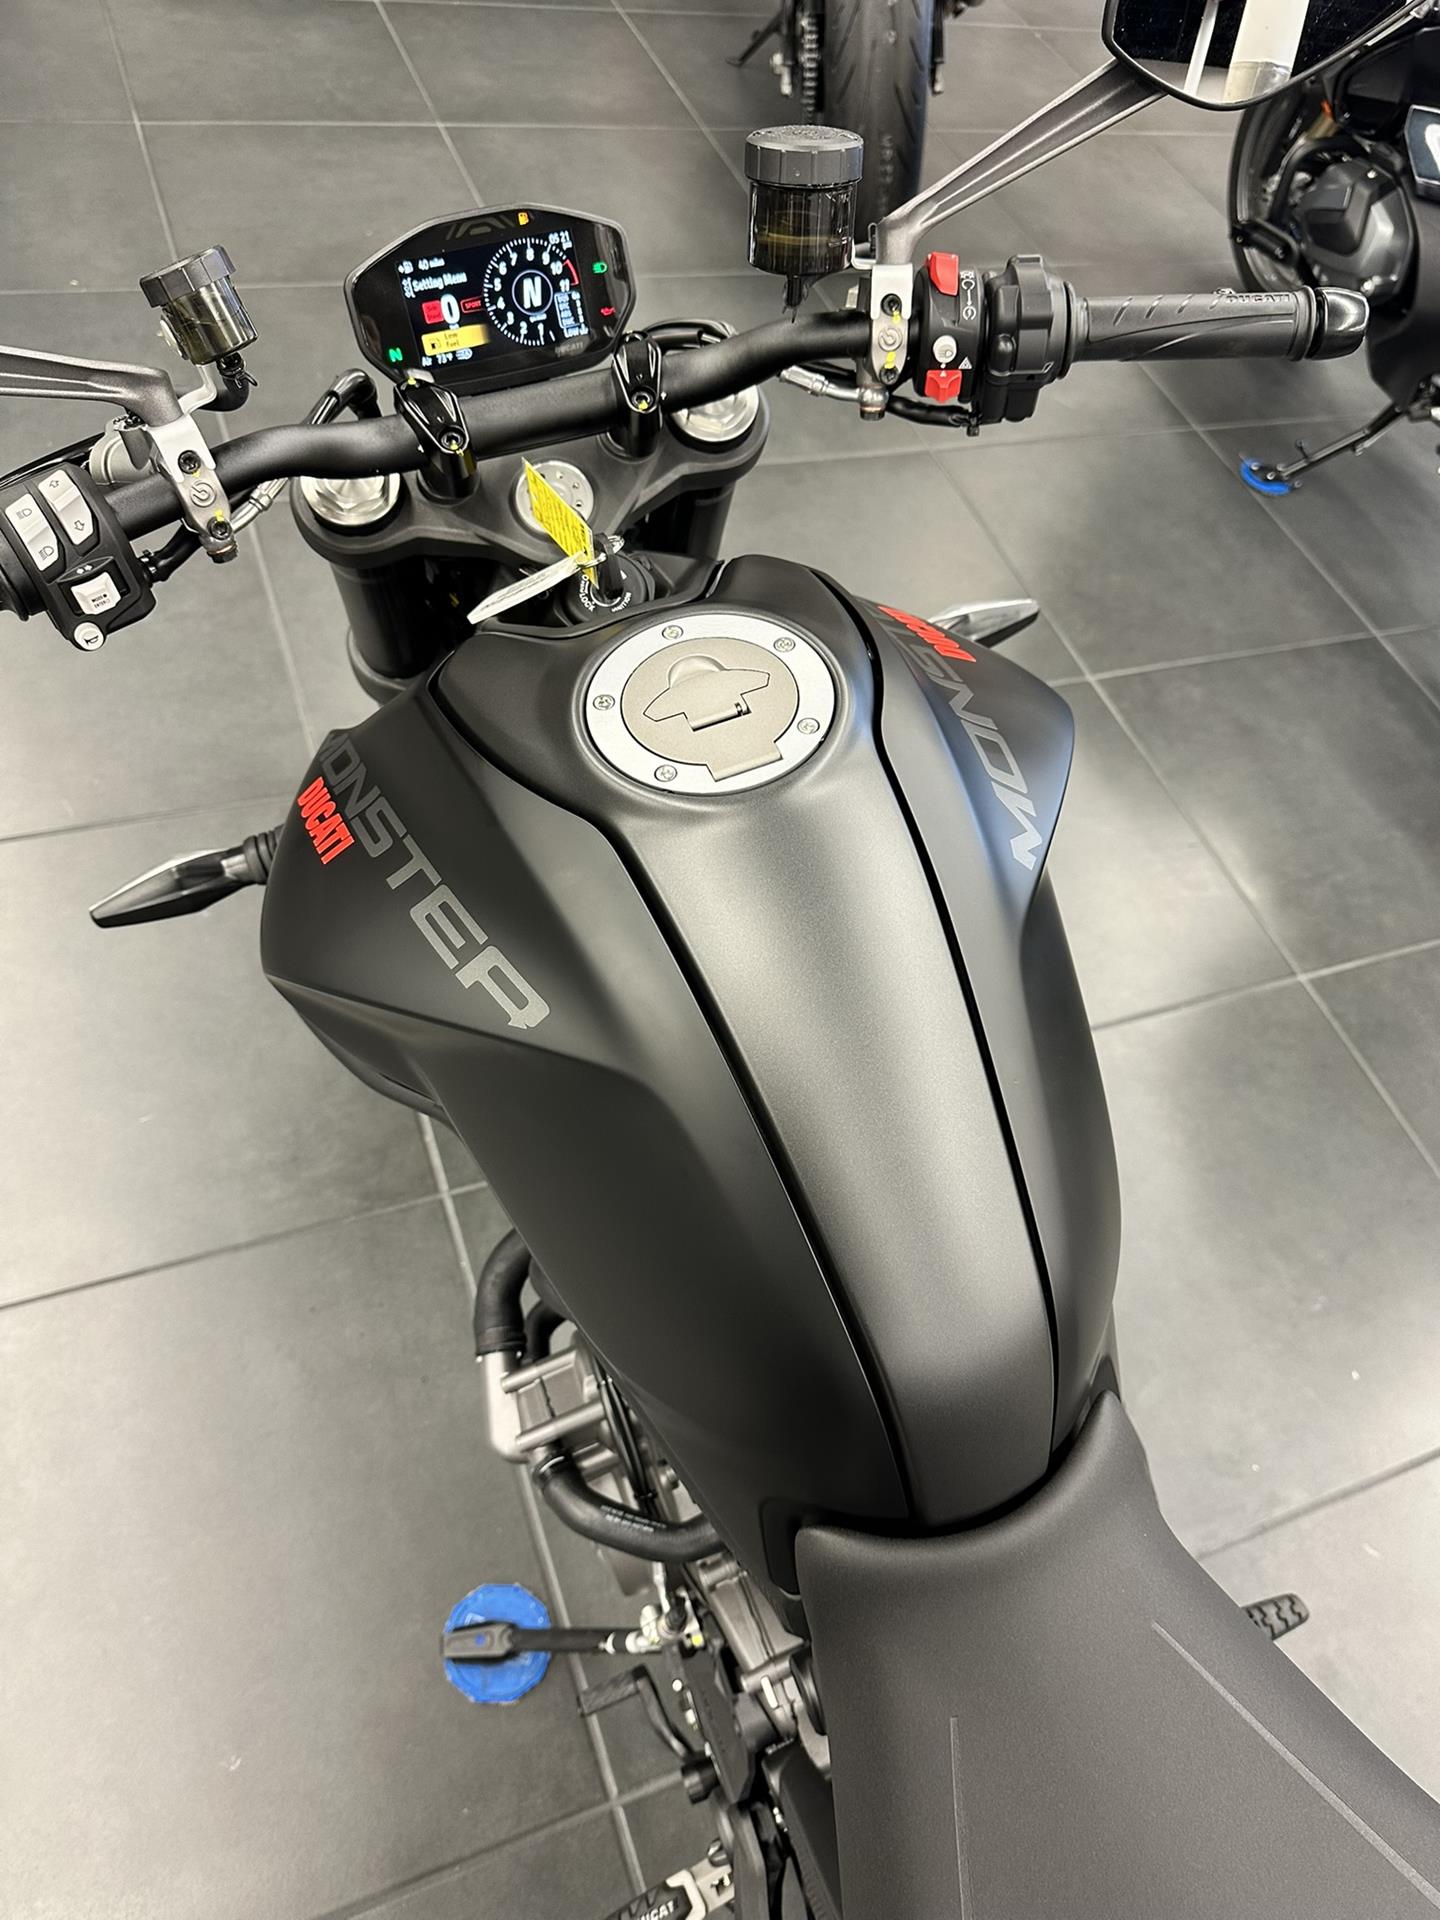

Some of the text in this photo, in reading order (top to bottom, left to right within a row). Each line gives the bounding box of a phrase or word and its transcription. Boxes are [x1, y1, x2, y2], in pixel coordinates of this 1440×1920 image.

[509, 252, 518, 267] 7
[550, 260, 563, 276] 10
[494, 277, 502, 292] 5
[523, 275, 542, 310] N
[440, 293, 460, 325] 0
[297, 776, 355, 865] DUCATI
